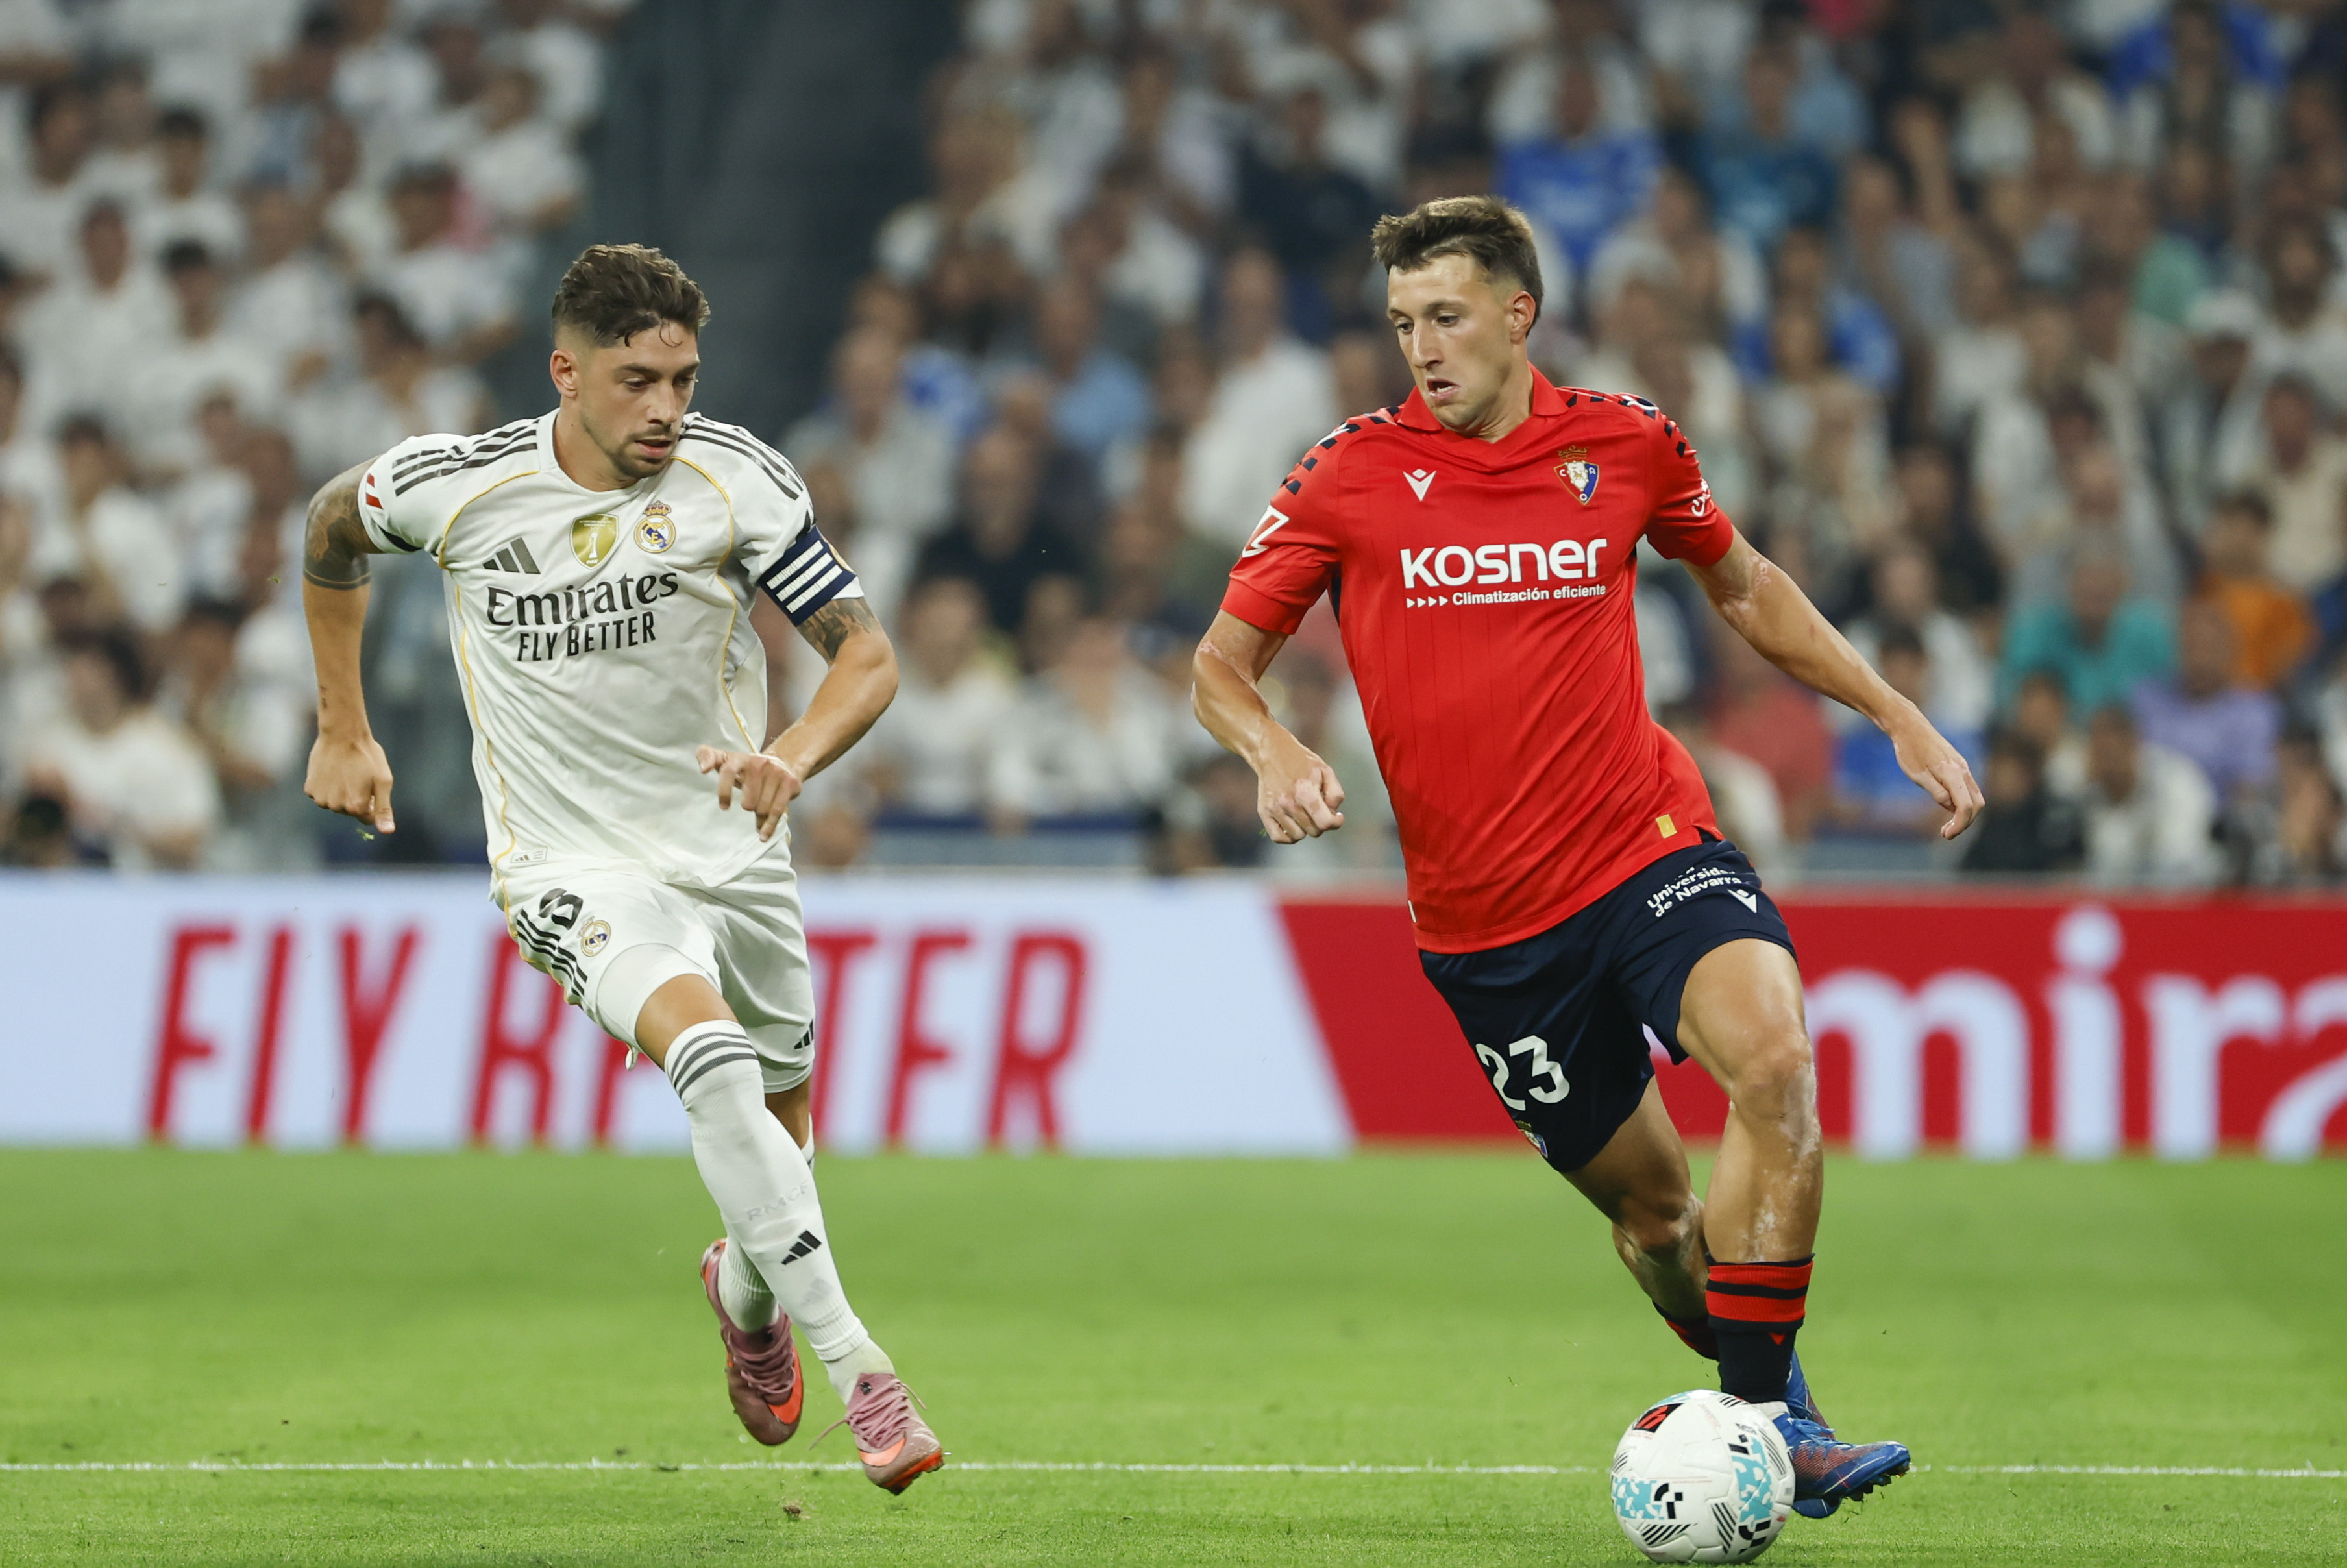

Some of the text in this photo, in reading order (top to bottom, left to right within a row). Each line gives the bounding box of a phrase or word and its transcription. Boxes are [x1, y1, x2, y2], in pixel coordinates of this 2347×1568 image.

[487, 572, 679, 626] Emirates
[1452, 584, 1606, 606] Climatización eficiente
[517, 611, 656, 661] FLY BETTER
[1647, 867, 1736, 909] Universid
[1655, 877, 1743, 918] de Navarra
[1475, 1035, 1571, 1112] 23
